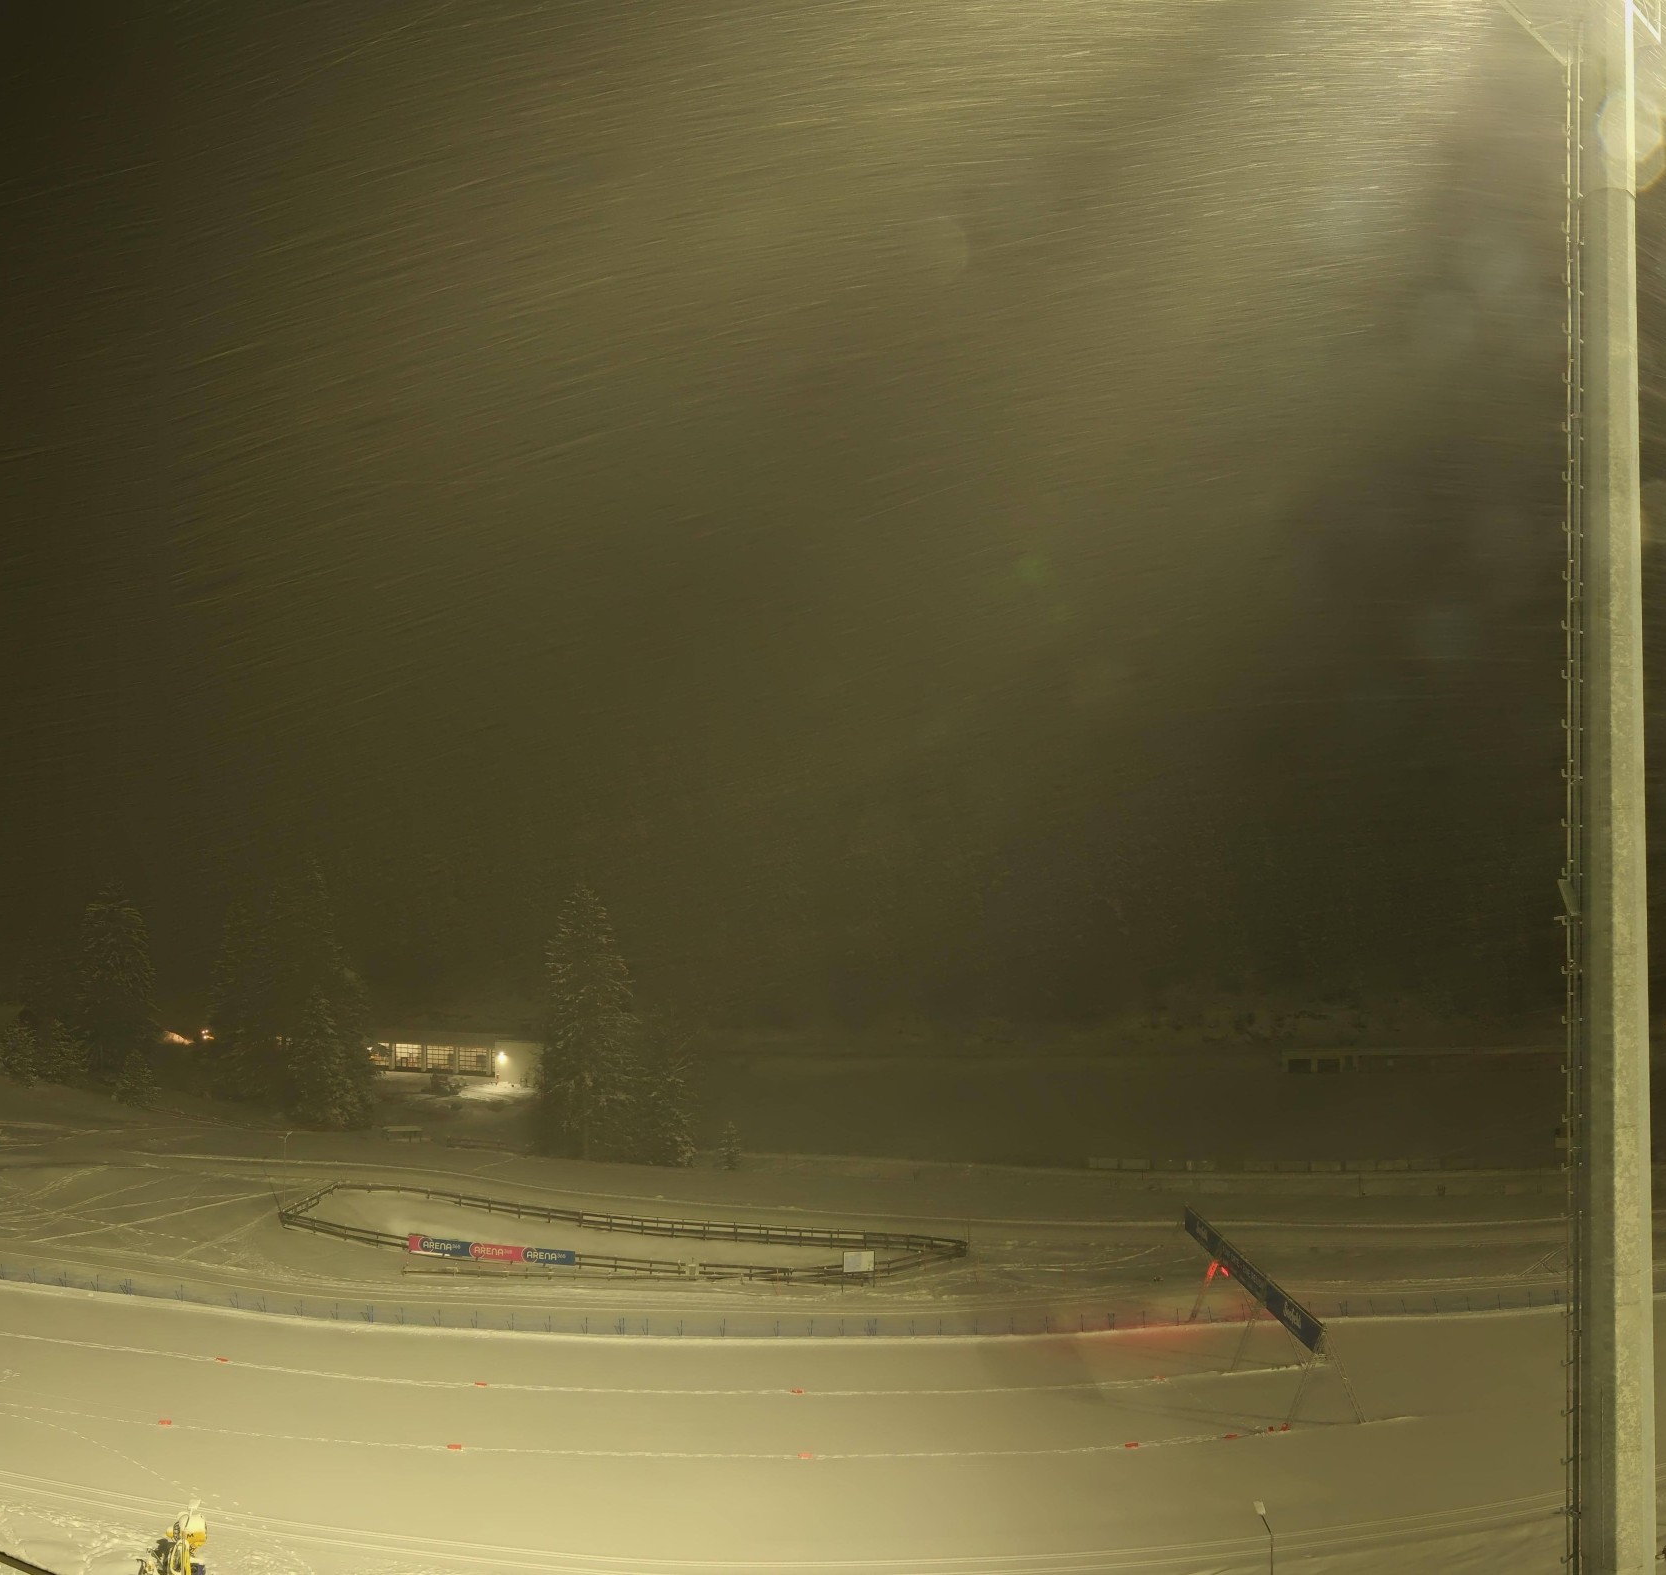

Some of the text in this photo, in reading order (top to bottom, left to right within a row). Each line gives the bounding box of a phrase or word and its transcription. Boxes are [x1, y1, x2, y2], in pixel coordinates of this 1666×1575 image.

[422, 1240, 452, 1251] ARENA
[474, 1246, 504, 1256] ARENA
[526, 1250, 557, 1261] ARENA
